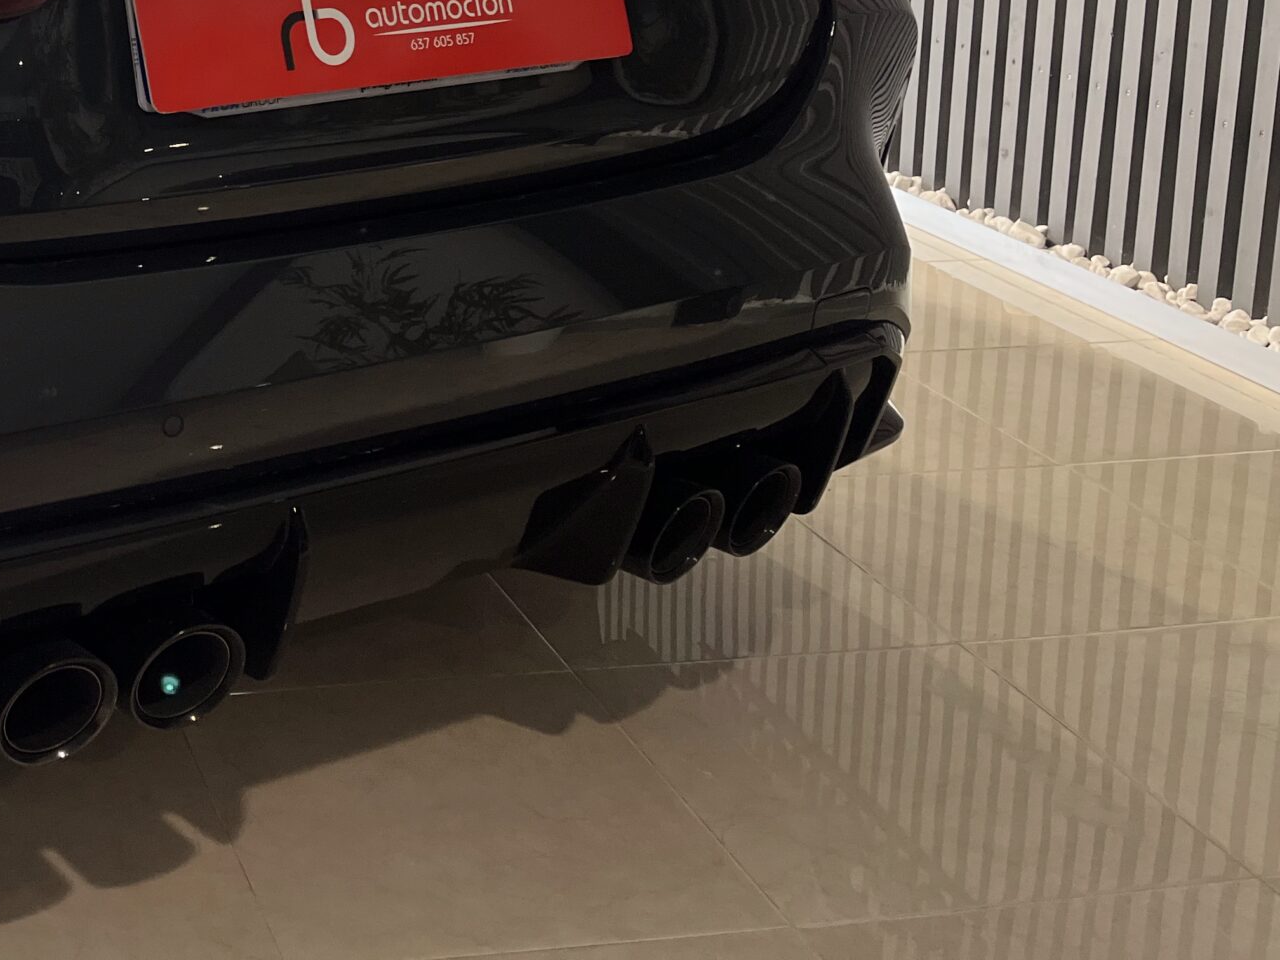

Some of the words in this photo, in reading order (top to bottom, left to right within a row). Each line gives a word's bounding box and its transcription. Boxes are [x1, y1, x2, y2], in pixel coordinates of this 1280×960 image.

[410, 38, 430, 51] 637
[433, 35, 454, 48] 605
[456, 32, 475, 45] 857
